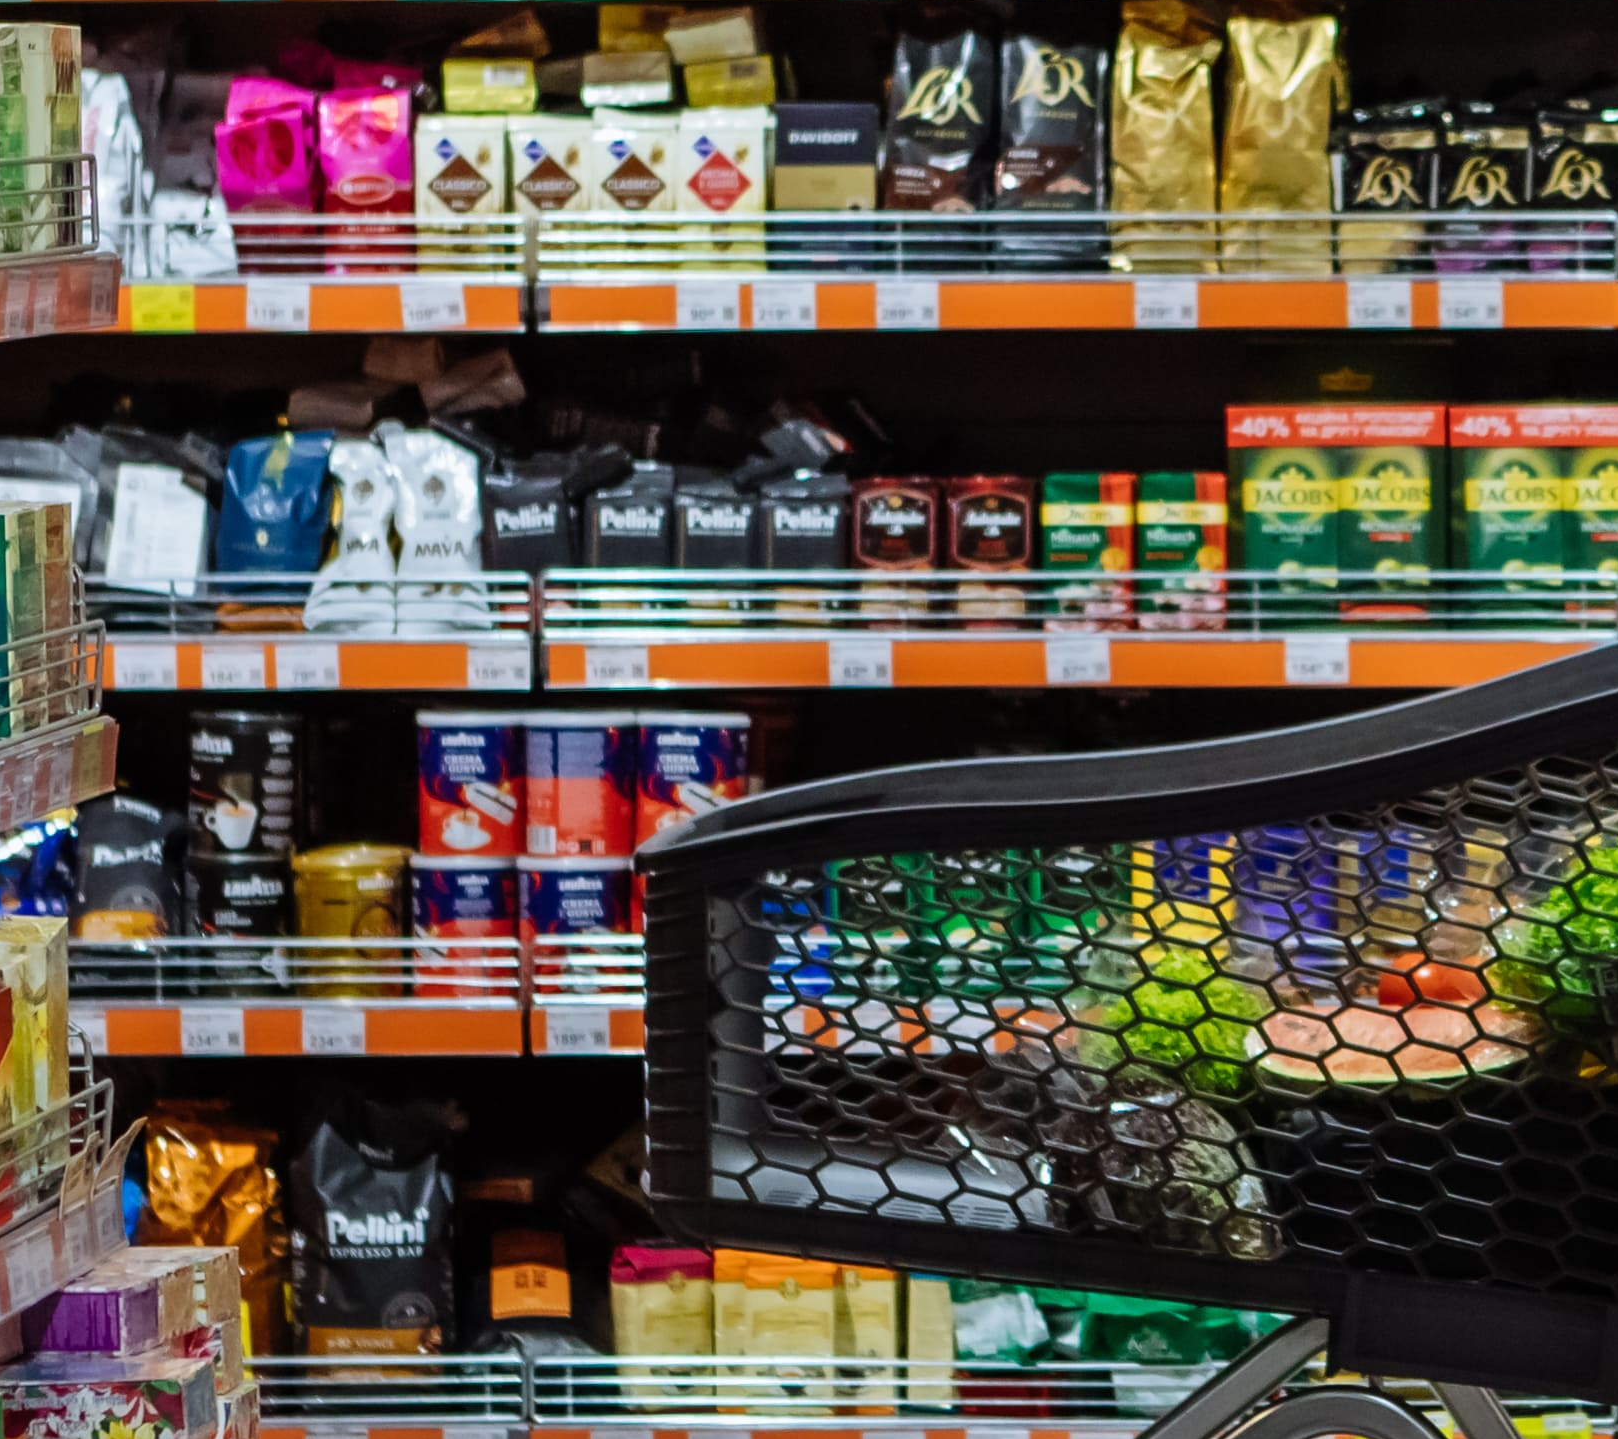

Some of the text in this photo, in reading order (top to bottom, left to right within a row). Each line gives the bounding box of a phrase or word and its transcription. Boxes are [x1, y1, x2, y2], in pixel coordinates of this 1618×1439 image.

[1249, 484, 1337, 508] JACOBS
[1349, 484, 1431, 507] JACOBS
[1470, 484, 1562, 508] JACOBS
[495, 506, 557, 534] Pellini
[600, 506, 665, 534] Pellini
[688, 507, 752, 534] Pellini
[774, 506, 839, 533] Pellini
[327, 1207, 429, 1244] Pellini
